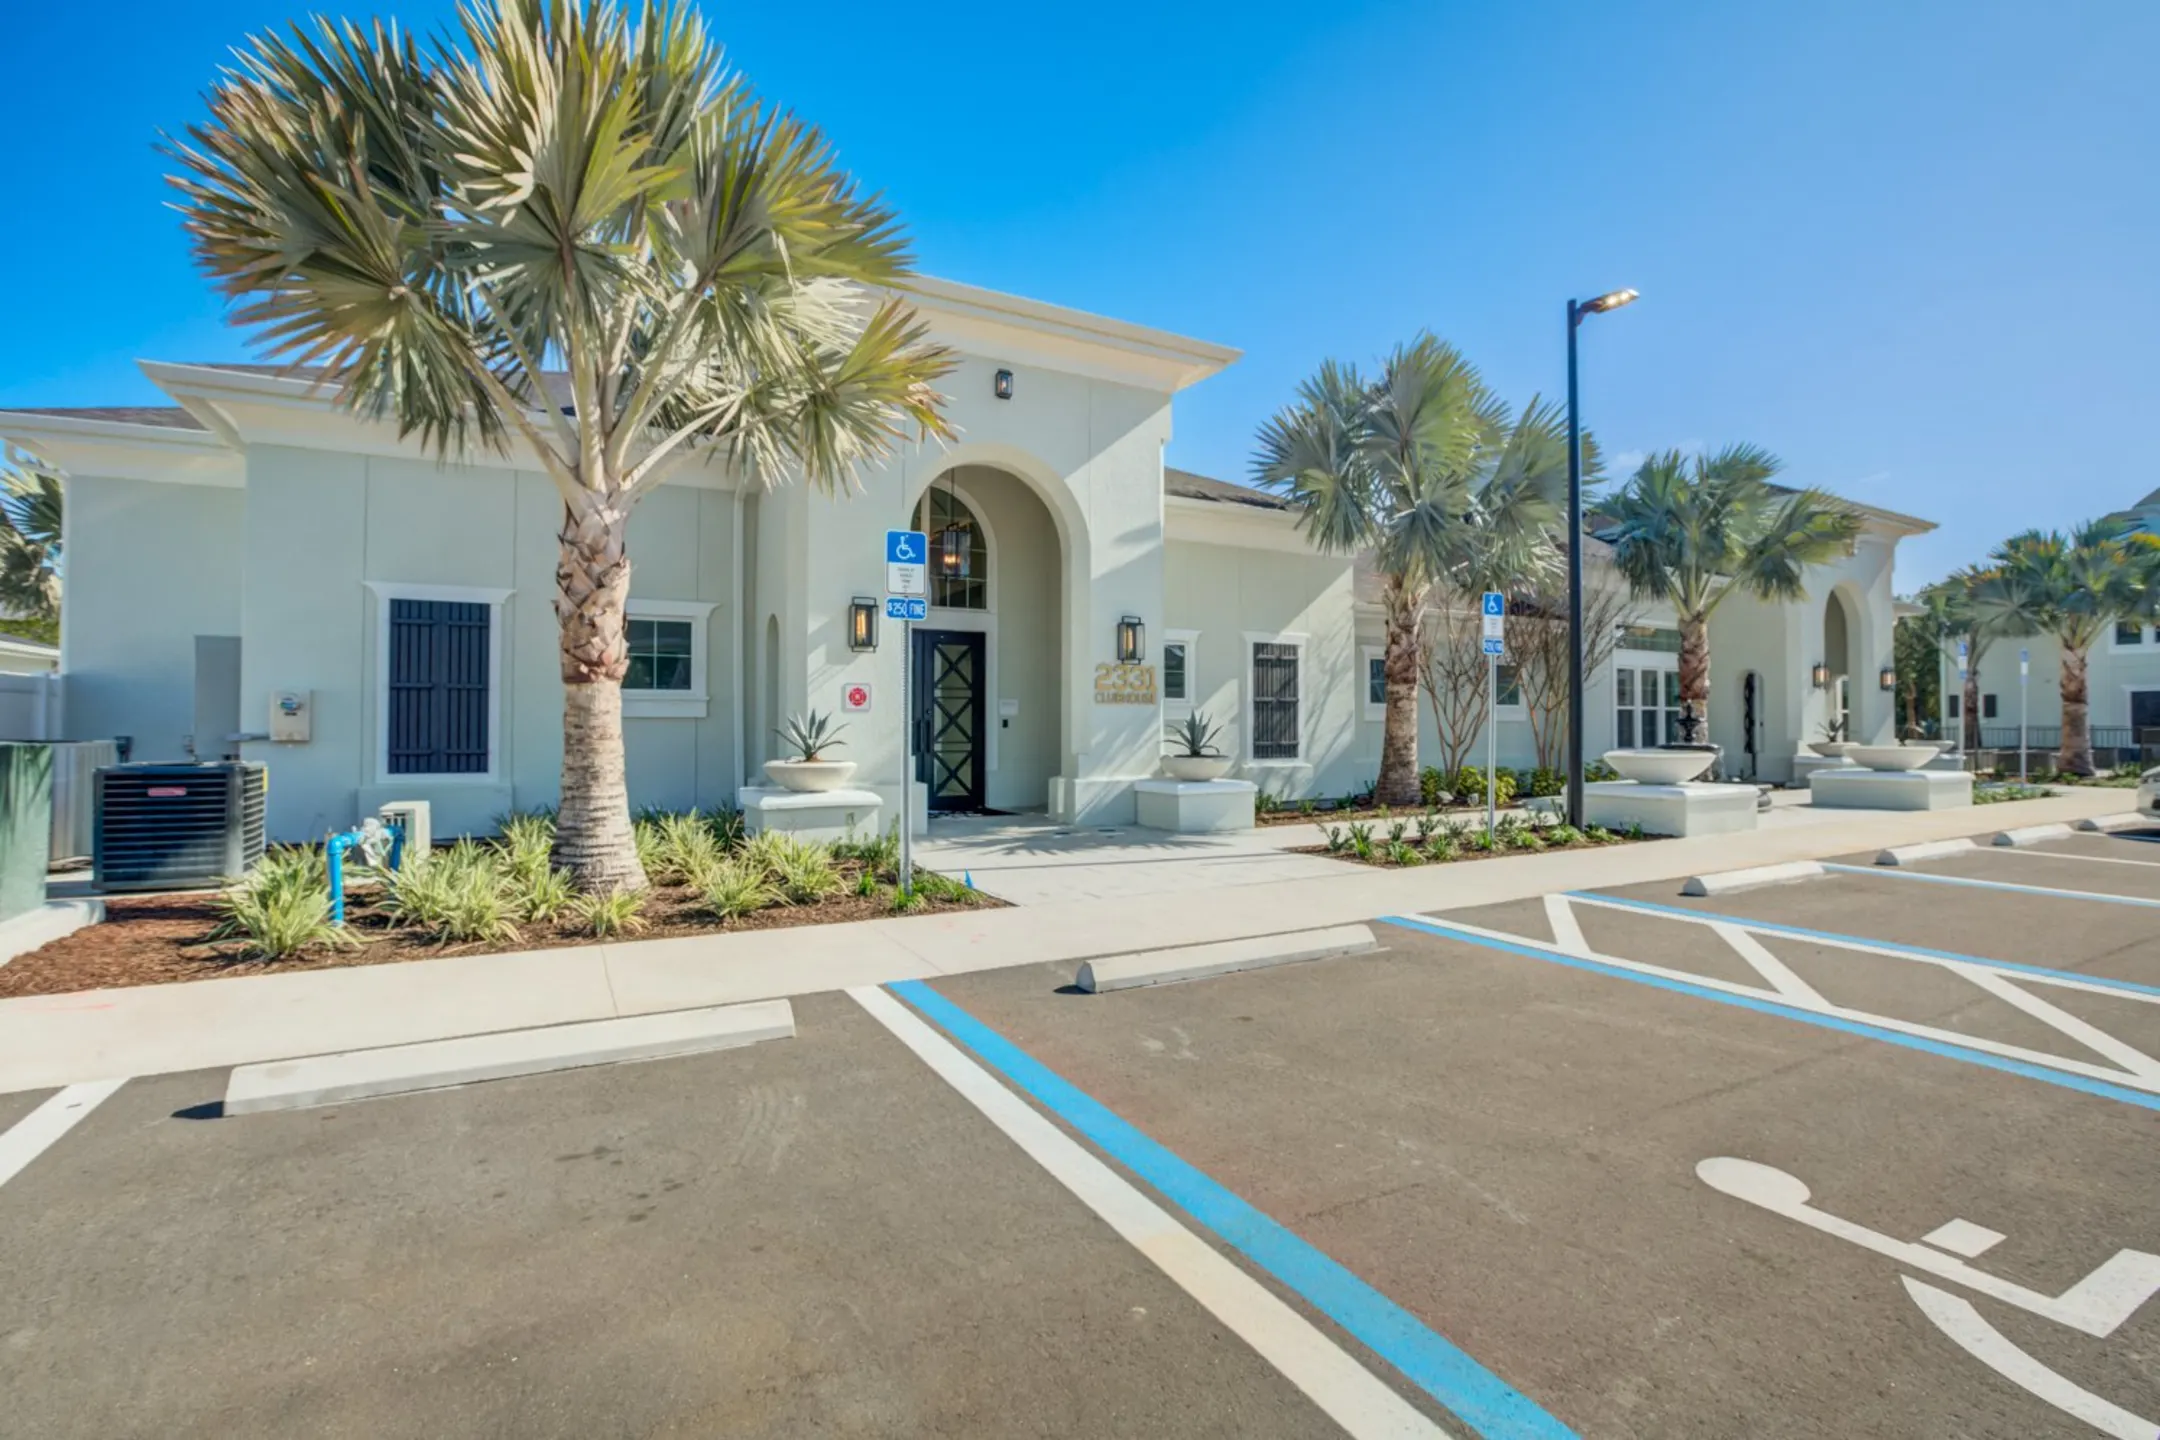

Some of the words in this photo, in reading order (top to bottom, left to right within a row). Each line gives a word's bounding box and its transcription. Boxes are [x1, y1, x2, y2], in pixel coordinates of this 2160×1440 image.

[909, 603, 925, 617] FINE
[1095, 664, 1156, 691] 2331
[1095, 691, 1156, 704] CLUBHOUSE
